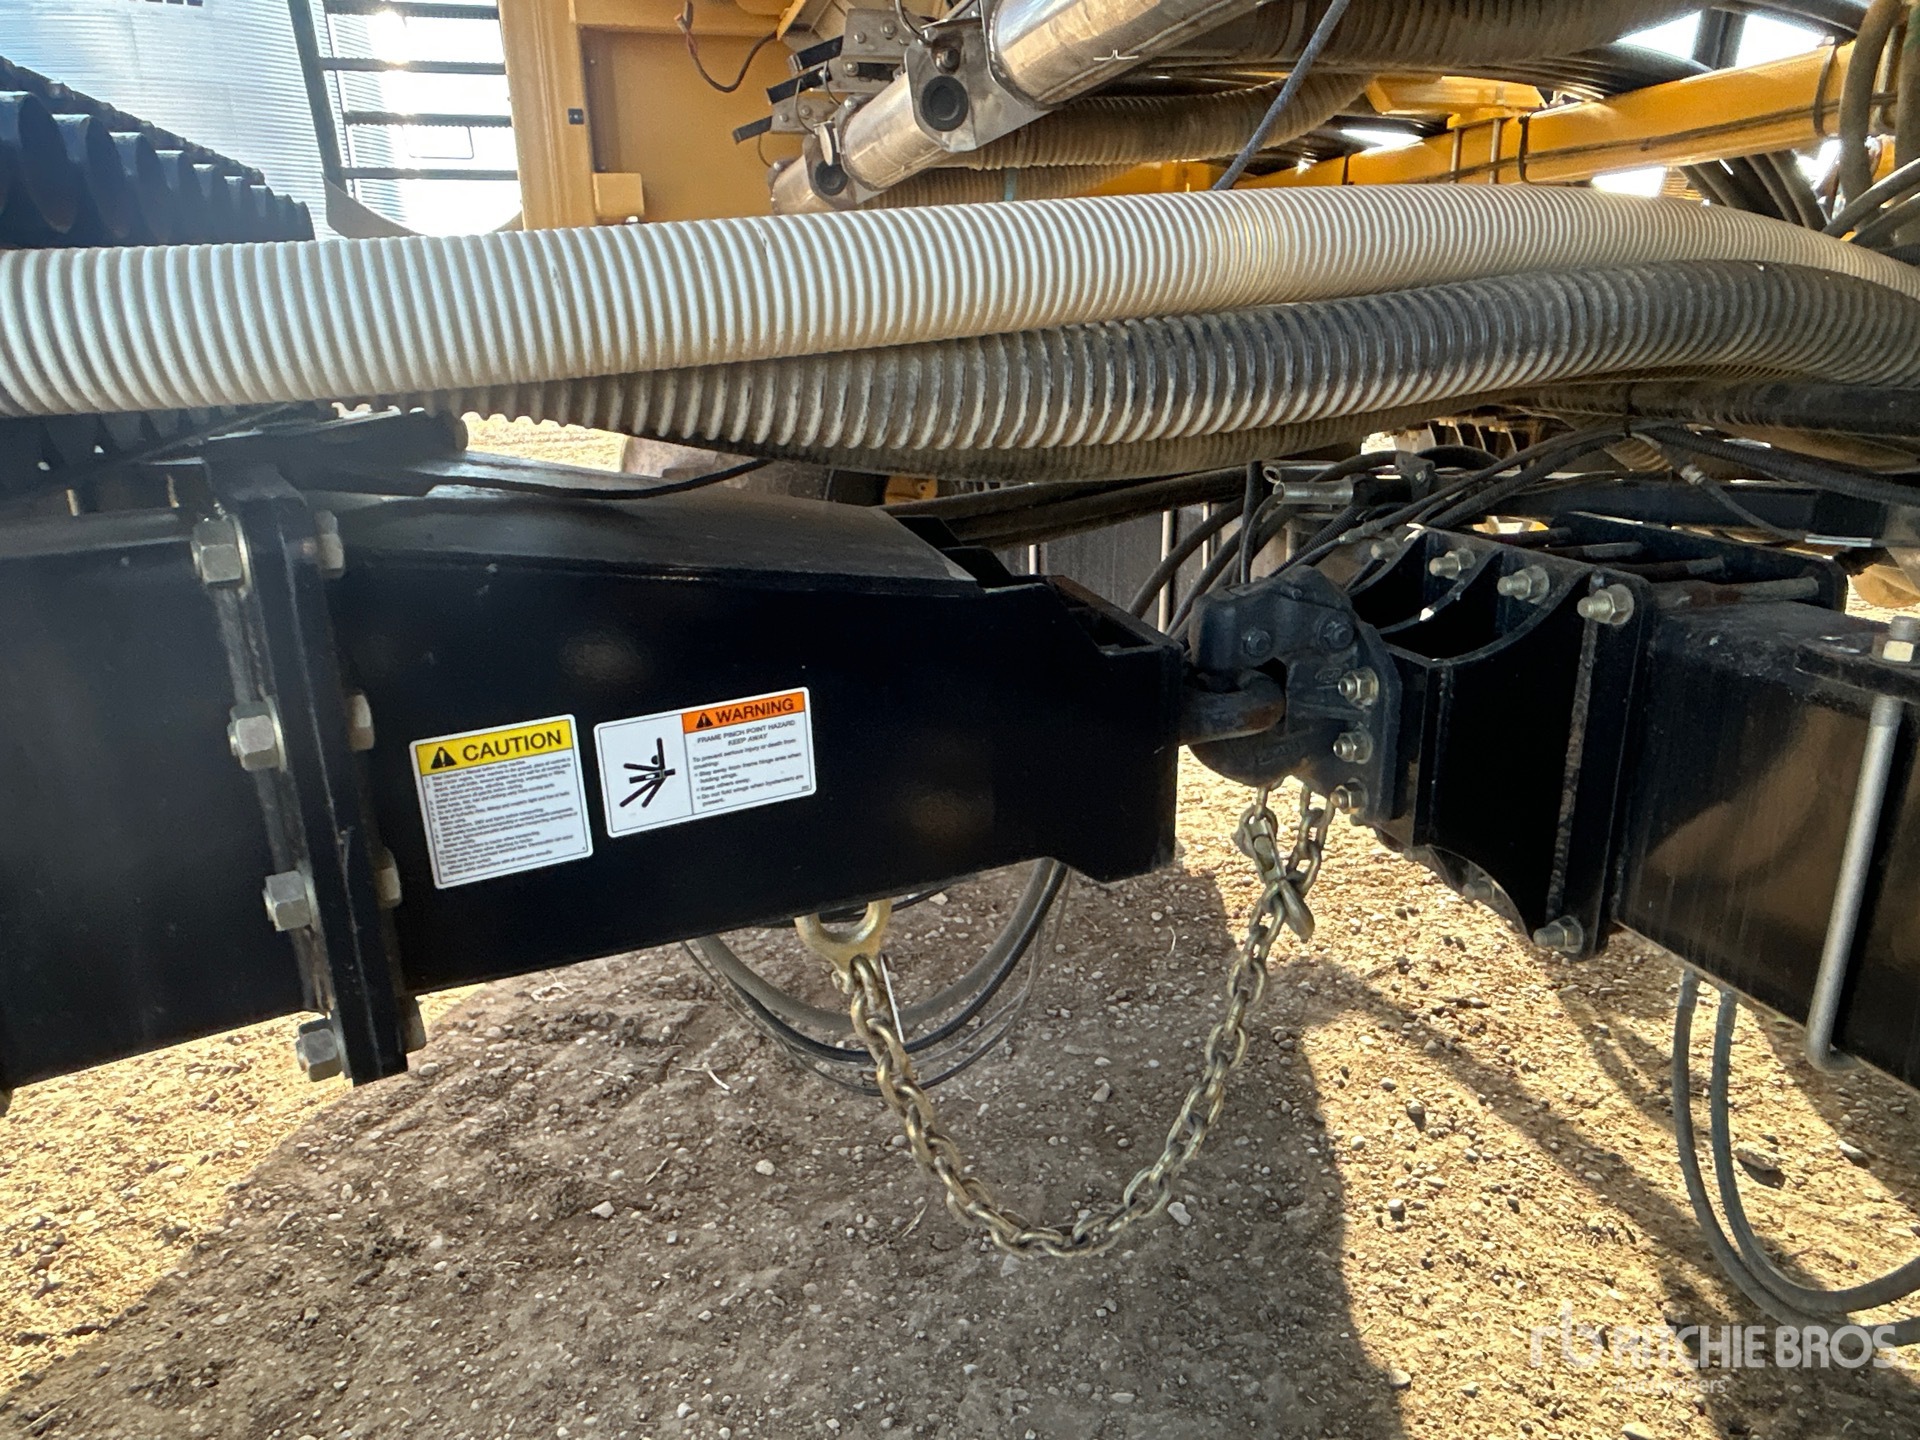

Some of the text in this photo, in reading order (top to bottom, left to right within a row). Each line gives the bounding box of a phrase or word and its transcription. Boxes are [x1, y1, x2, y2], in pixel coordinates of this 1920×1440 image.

[716, 698, 795, 724] WARNING
[697, 719, 796, 744] FRAME PINCH POINT HAZARD
[727, 732, 769, 746] KEEP AWAY
[462, 729, 562, 761] CAUTION
